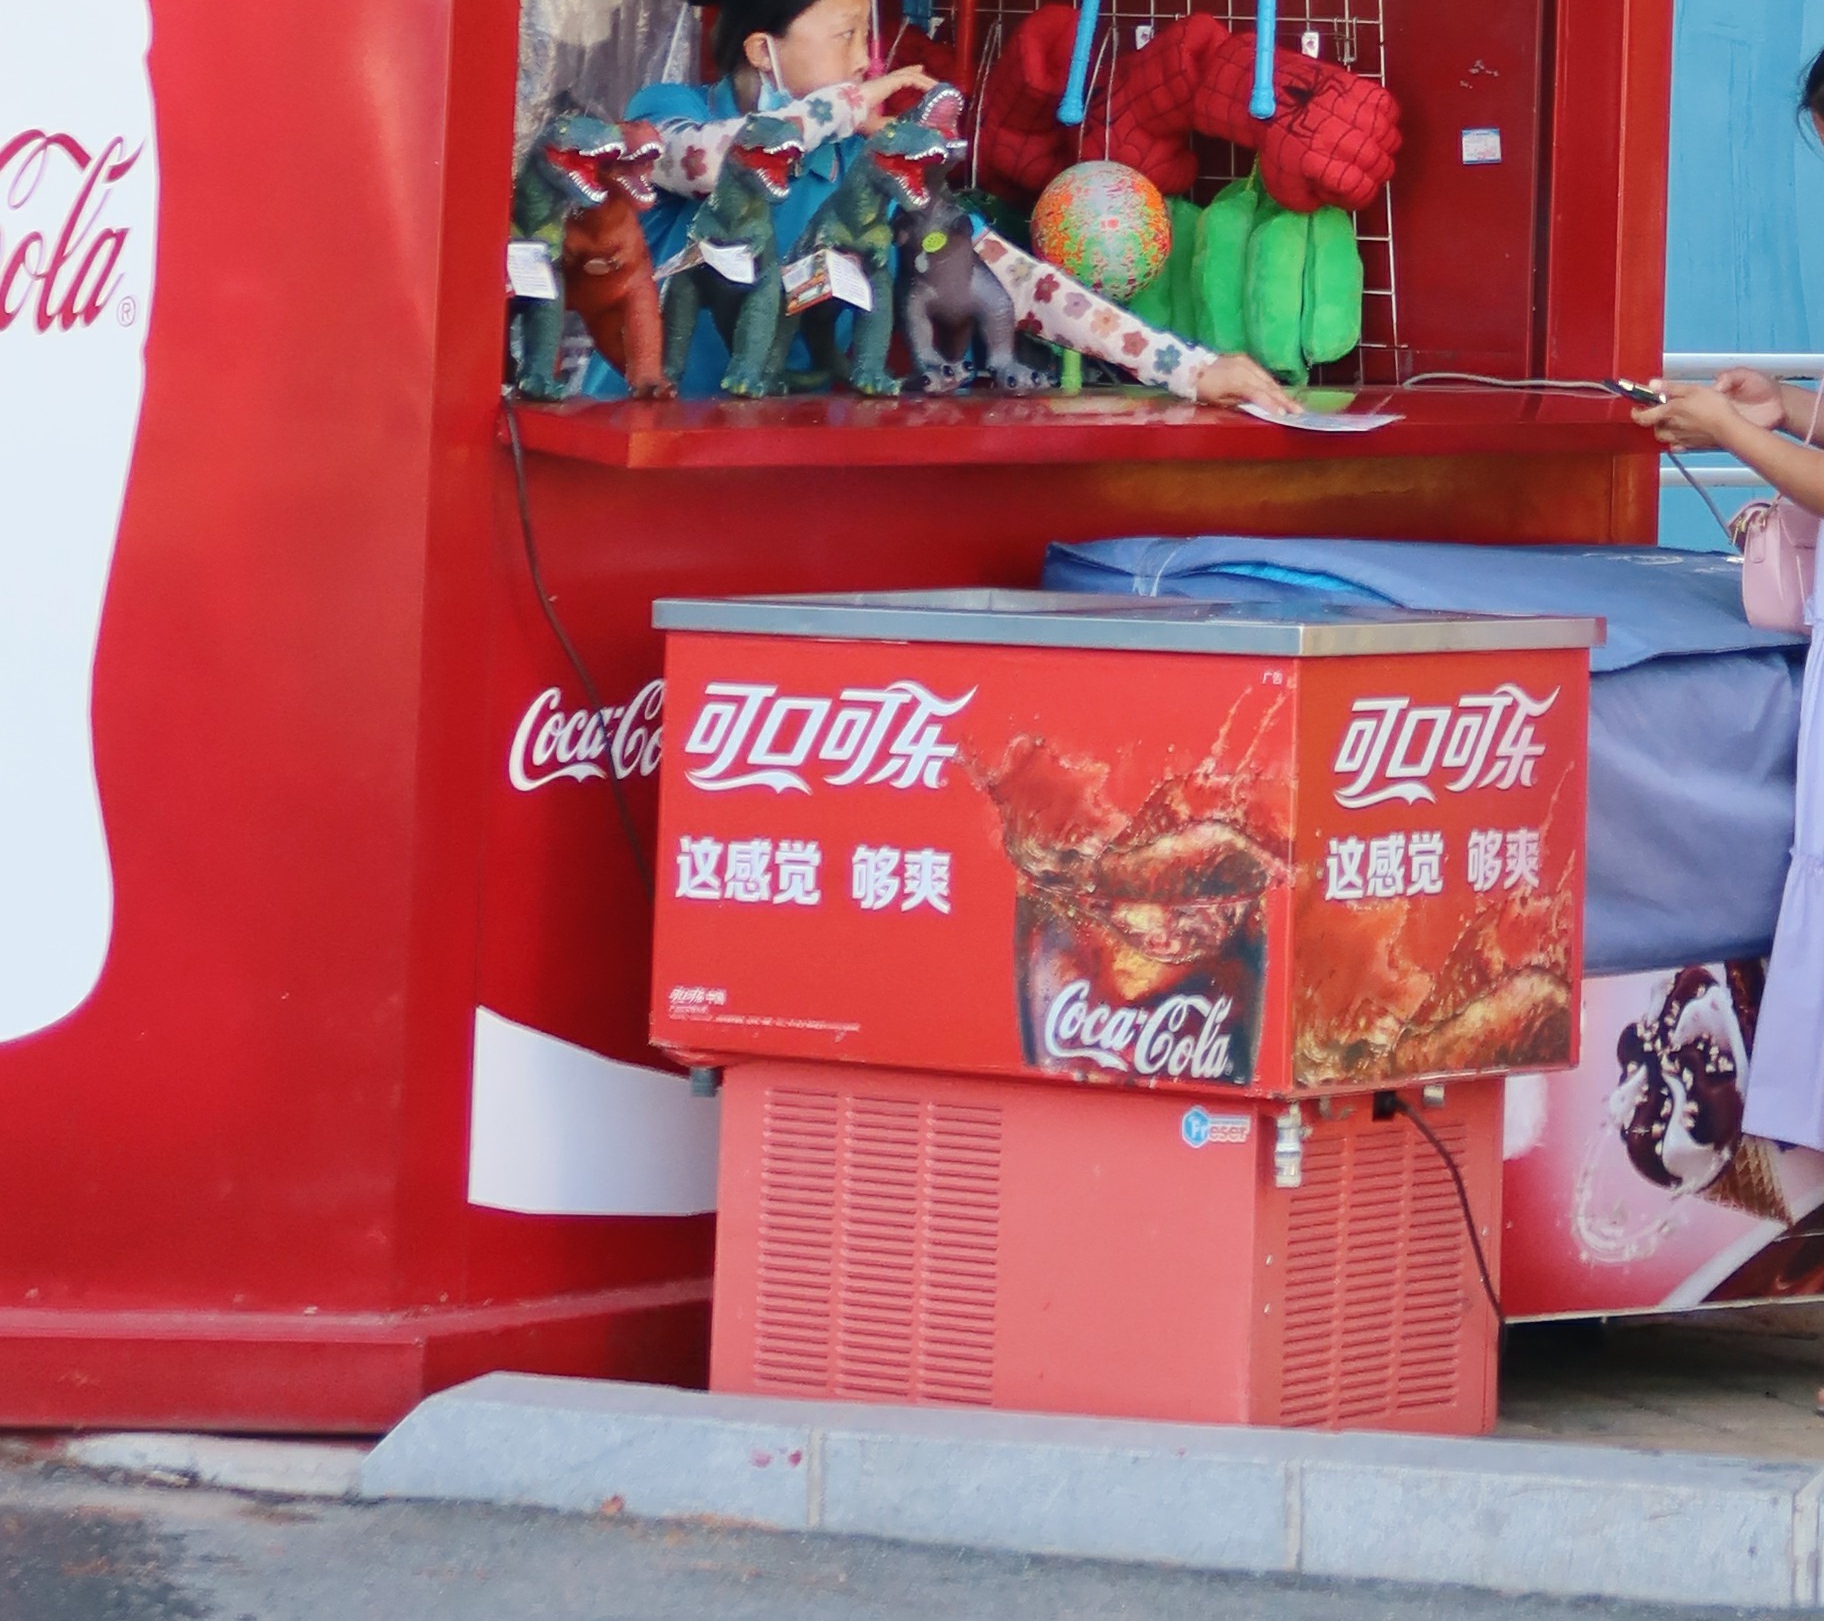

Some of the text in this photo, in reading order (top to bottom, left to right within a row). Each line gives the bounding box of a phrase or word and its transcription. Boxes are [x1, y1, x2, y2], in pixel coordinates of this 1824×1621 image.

[0, 129, 146, 335] ola
[685, 680, 978, 795] 可口可乐
[1334, 683, 1561, 808] 可口可乐
[675, 835, 953, 915] 这感觉 够爽
[1325, 826, 1541, 901] 这感觉 够爽
[1045, 978, 1234, 1080] Coca-Cola
